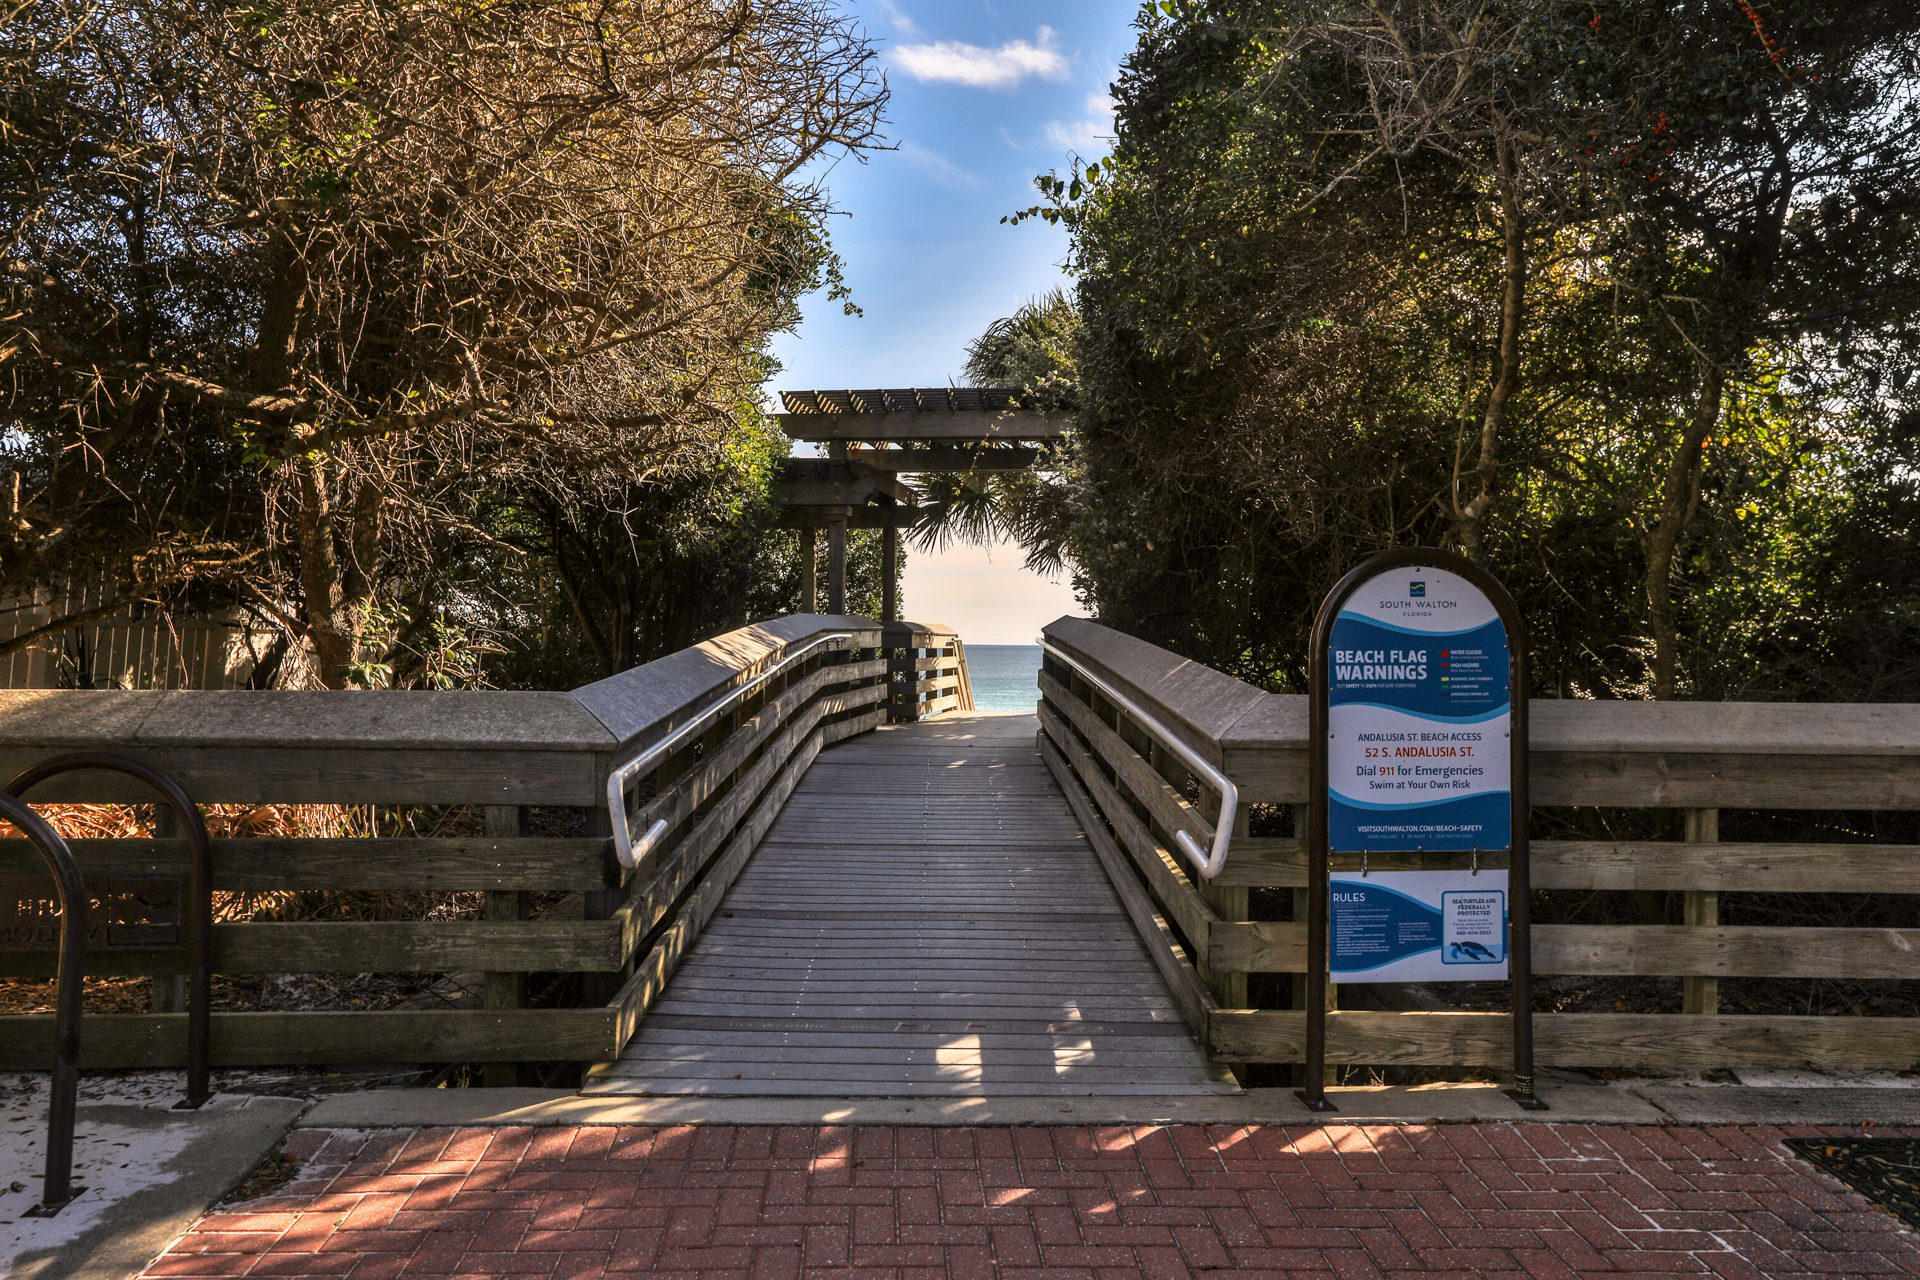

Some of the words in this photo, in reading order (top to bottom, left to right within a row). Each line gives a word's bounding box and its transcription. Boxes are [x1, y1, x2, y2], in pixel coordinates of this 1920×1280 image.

[1379, 600, 1411, 609] SOUTH
[1416, 600, 1457, 609] WALTON
[1335, 650, 1385, 663] BEACH
[1390, 650, 1427, 663] FLAG
[1335, 664, 1428, 680] WARNINGS
[1358, 733, 1405, 742] ANDALUSIA
[1407, 733, 1419, 742] ST.
[1420, 733, 1449, 741] BEACH
[1450, 732, 1482, 741] ACCESS
[1365, 748, 1379, 758] 52
[1382, 748, 1391, 758] S.
[1395, 747, 1457, 758] ANDALUSIA
[1459, 747, 1475, 757] ST.
[1356, 766, 1376, 776] Dial
[1379, 767, 1395, 776] 911
[1397, 766, 1412, 776] for
[1415, 766, 1484, 778] Emergencies
[1369, 781, 1394, 790] Swim
[1396, 781, 1405, 789] at
[1408, 781, 1427, 789] Your
[1429, 780, 1450, 789] Own
[1452, 780, 1471, 789] Risk
[1357, 825, 1483, 833] VISITSOUTHWALTON.COM/BEACH-SAFETY
[1333, 892, 1366, 903] RULES
